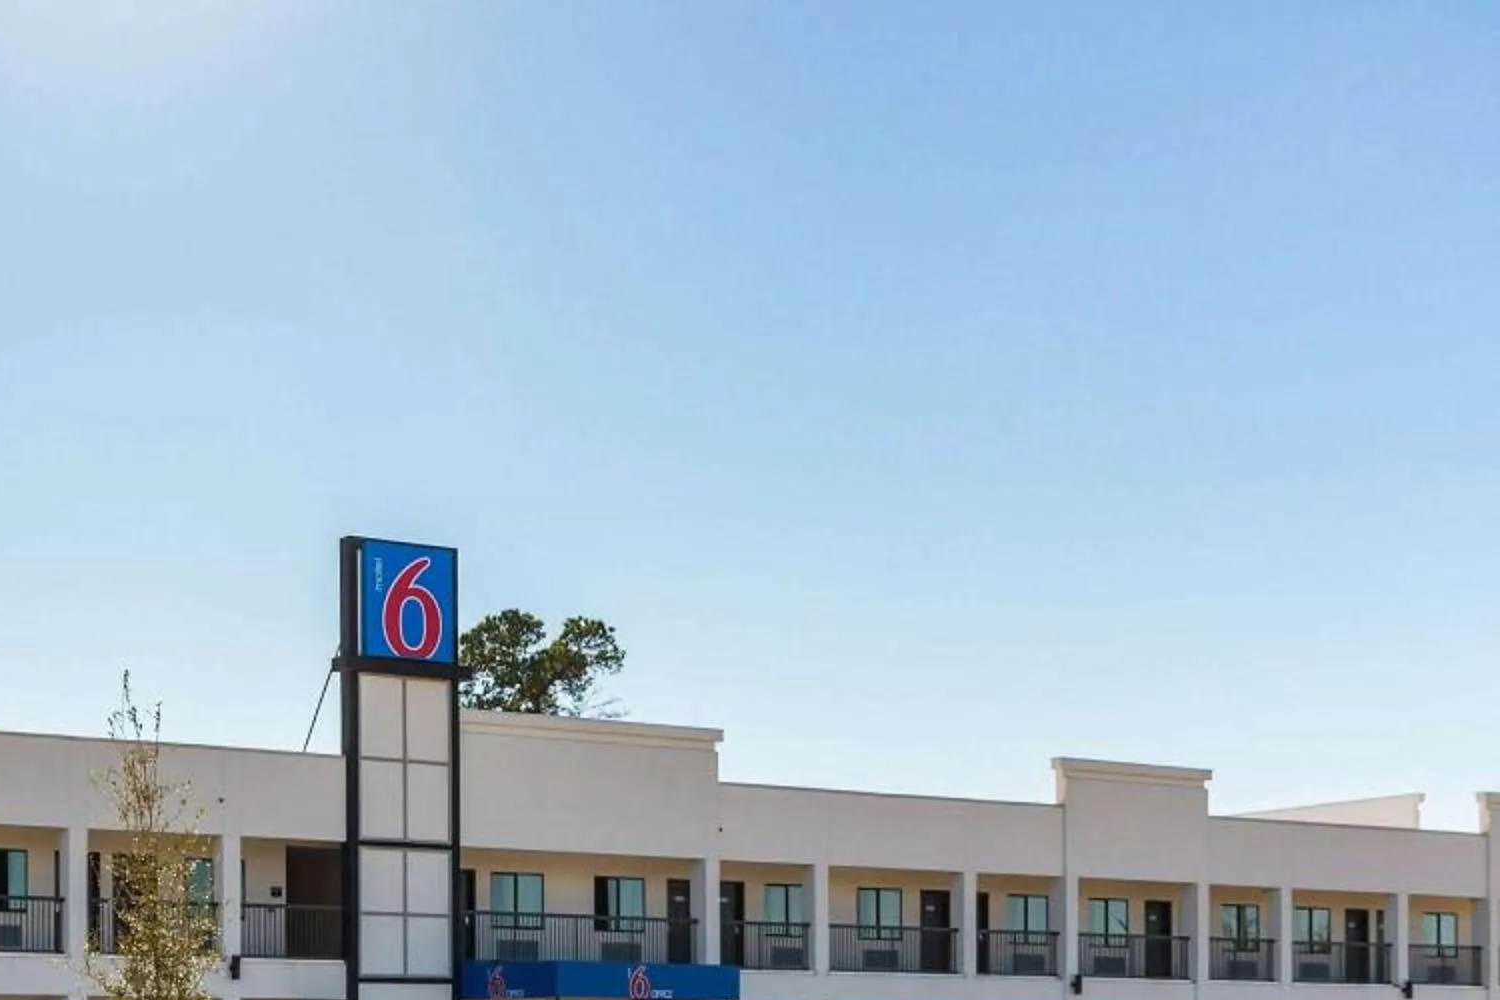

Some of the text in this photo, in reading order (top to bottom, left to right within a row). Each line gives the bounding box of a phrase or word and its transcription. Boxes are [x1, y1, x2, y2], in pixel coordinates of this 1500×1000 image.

[382, 556, 443, 659] 6
[488, 964, 506, 1000] 6
[629, 966, 650, 1000] 6
